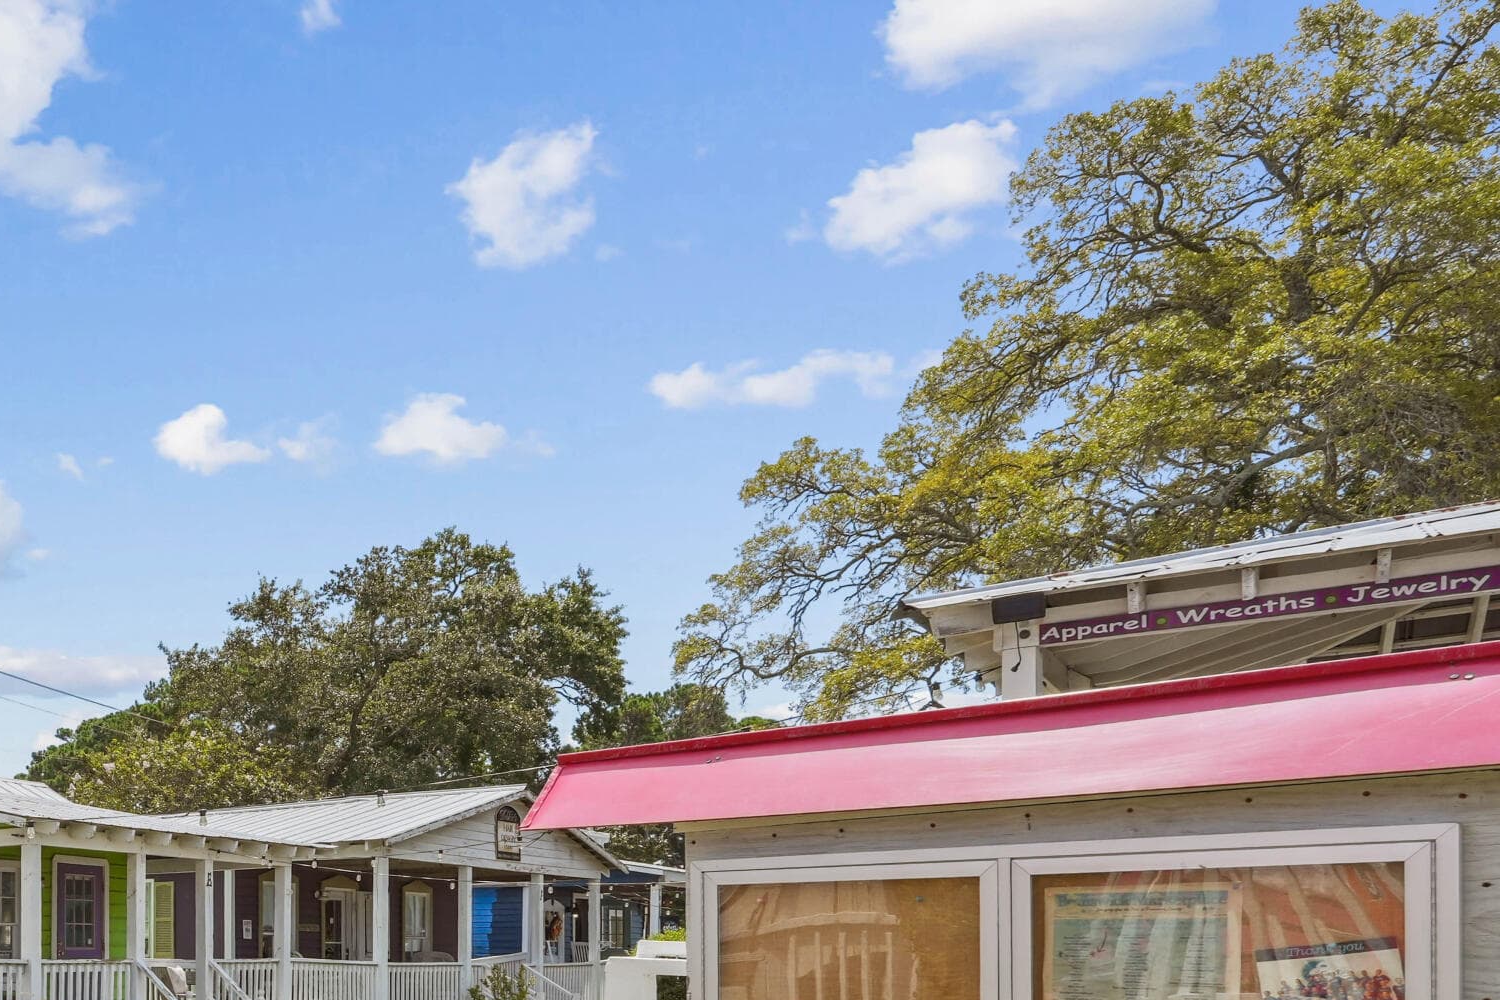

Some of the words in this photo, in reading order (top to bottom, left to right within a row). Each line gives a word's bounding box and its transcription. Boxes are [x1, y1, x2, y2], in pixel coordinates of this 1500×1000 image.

[1041, 614, 1148, 642] Apparel
[1176, 595, 1316, 625] Wreaths
[1346, 573, 1492, 603] Jewelry
